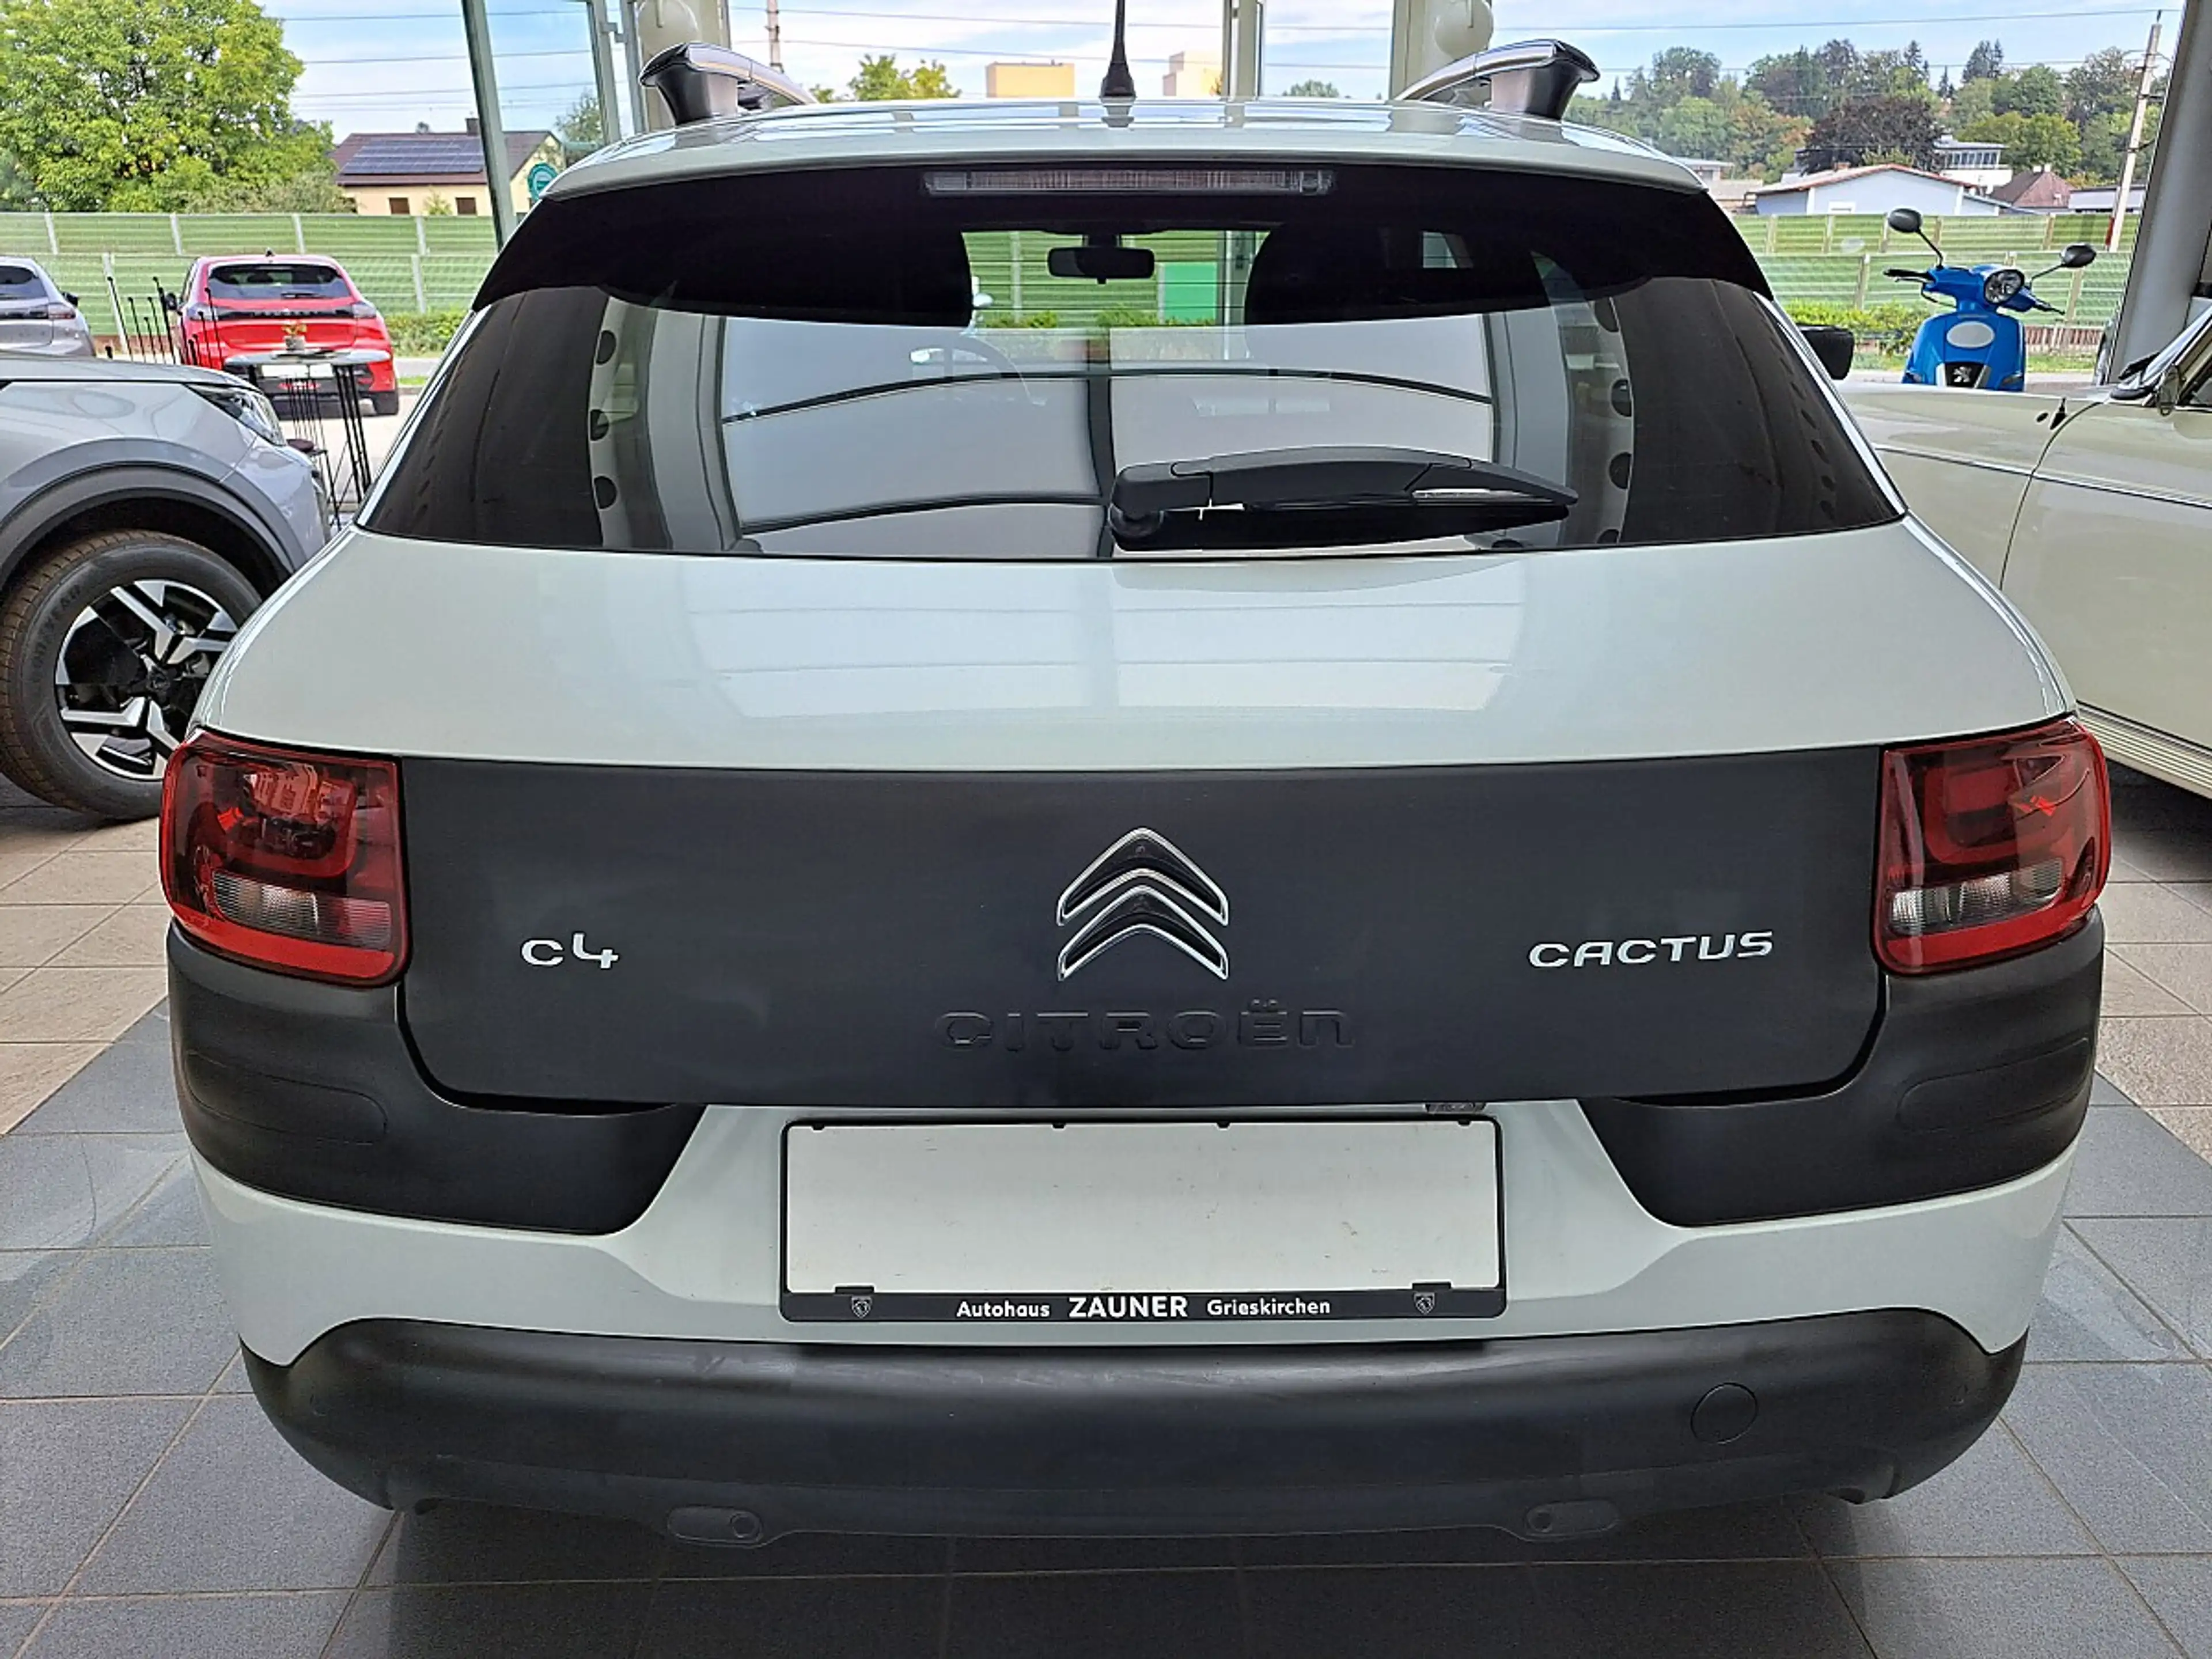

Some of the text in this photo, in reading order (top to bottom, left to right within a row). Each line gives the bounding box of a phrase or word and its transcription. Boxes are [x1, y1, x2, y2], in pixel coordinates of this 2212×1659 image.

[521, 933, 619, 969] C4
[1529, 931, 1773, 967] CACTUS
[956, 1296, 1330, 1318] Autohaus ZAUNER Grieskirchen
